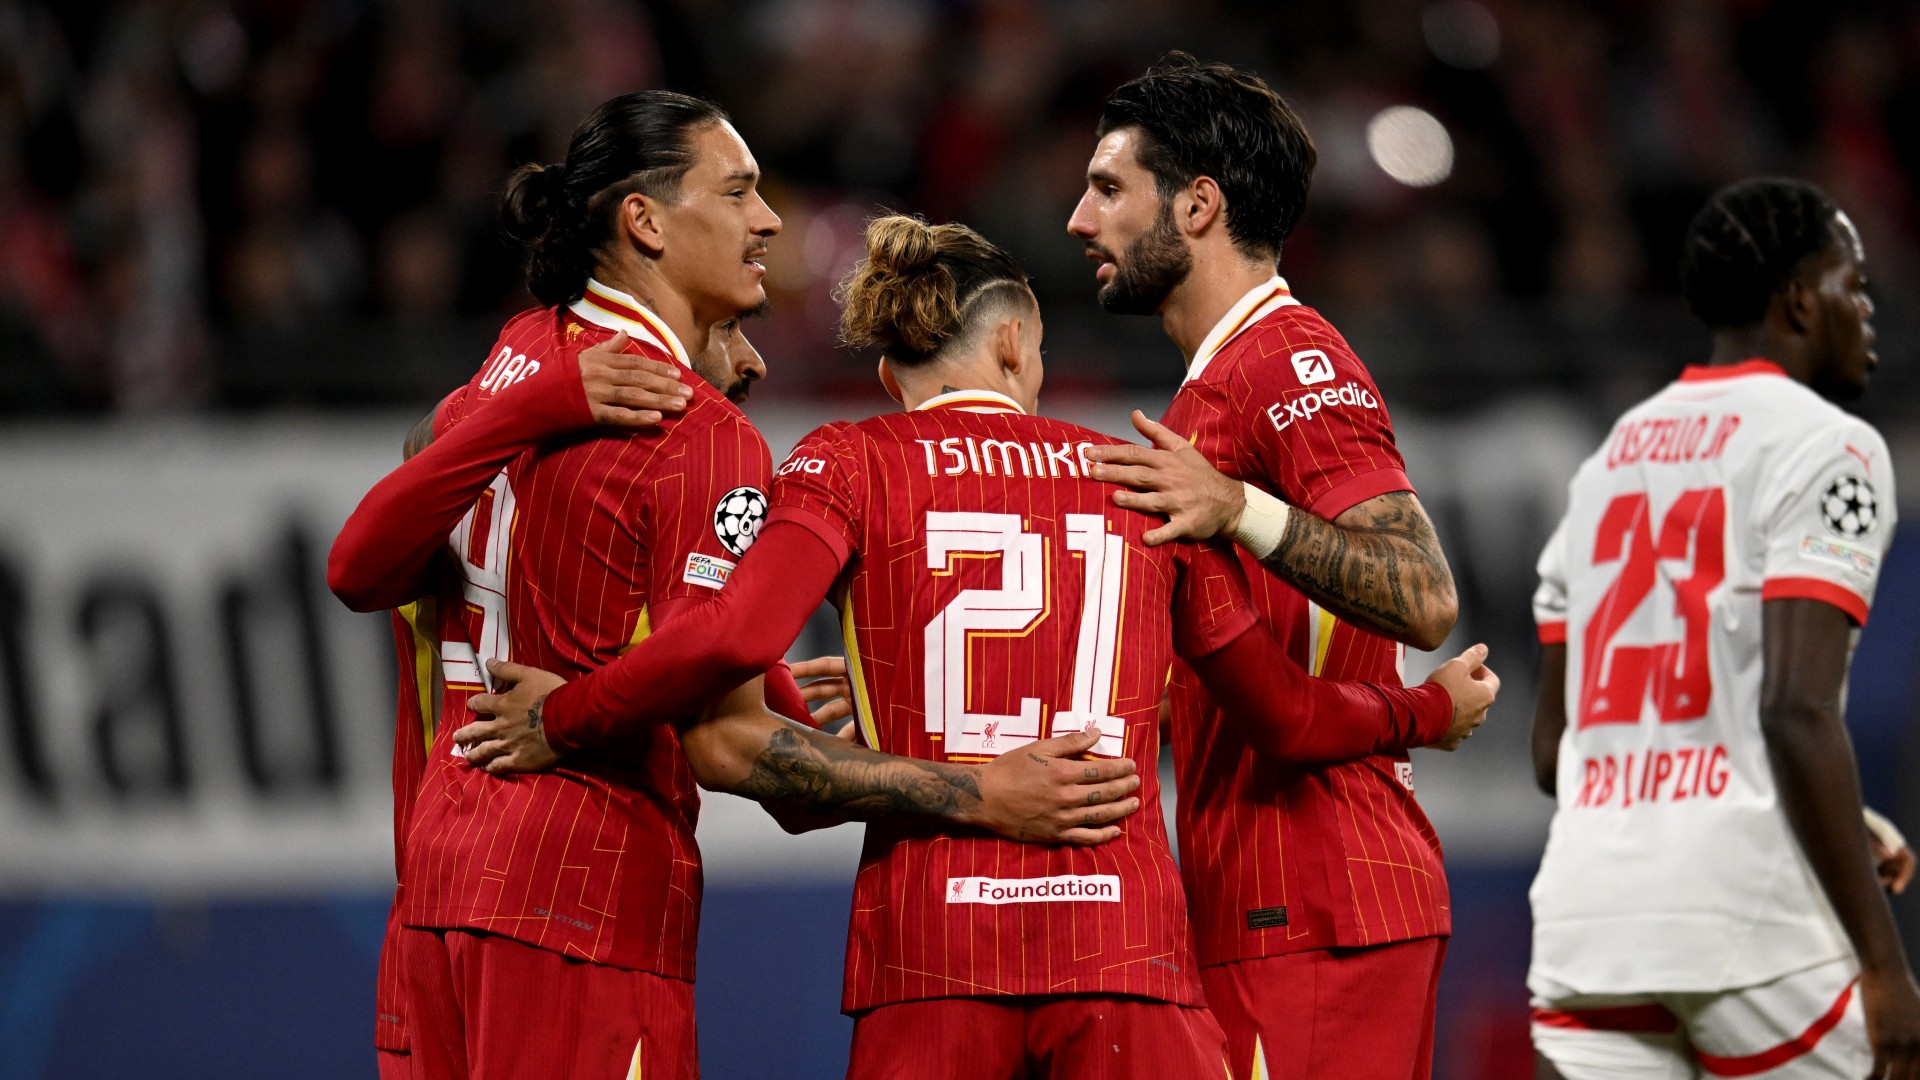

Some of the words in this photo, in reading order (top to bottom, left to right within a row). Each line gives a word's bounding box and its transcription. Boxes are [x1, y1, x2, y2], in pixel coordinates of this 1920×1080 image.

[1266, 381, 1378, 432] Expedia
[777, 456, 826, 476] dia
[738, 509, 754, 536] 6
[687, 562, 731, 581] FOUN
[690, 554, 712, 565] UEFA
[1577, 486, 1726, 733] 23
[924, 511, 1127, 758] 21
[1574, 754, 1618, 809] RB
[978, 880, 1112, 900] Foundation
